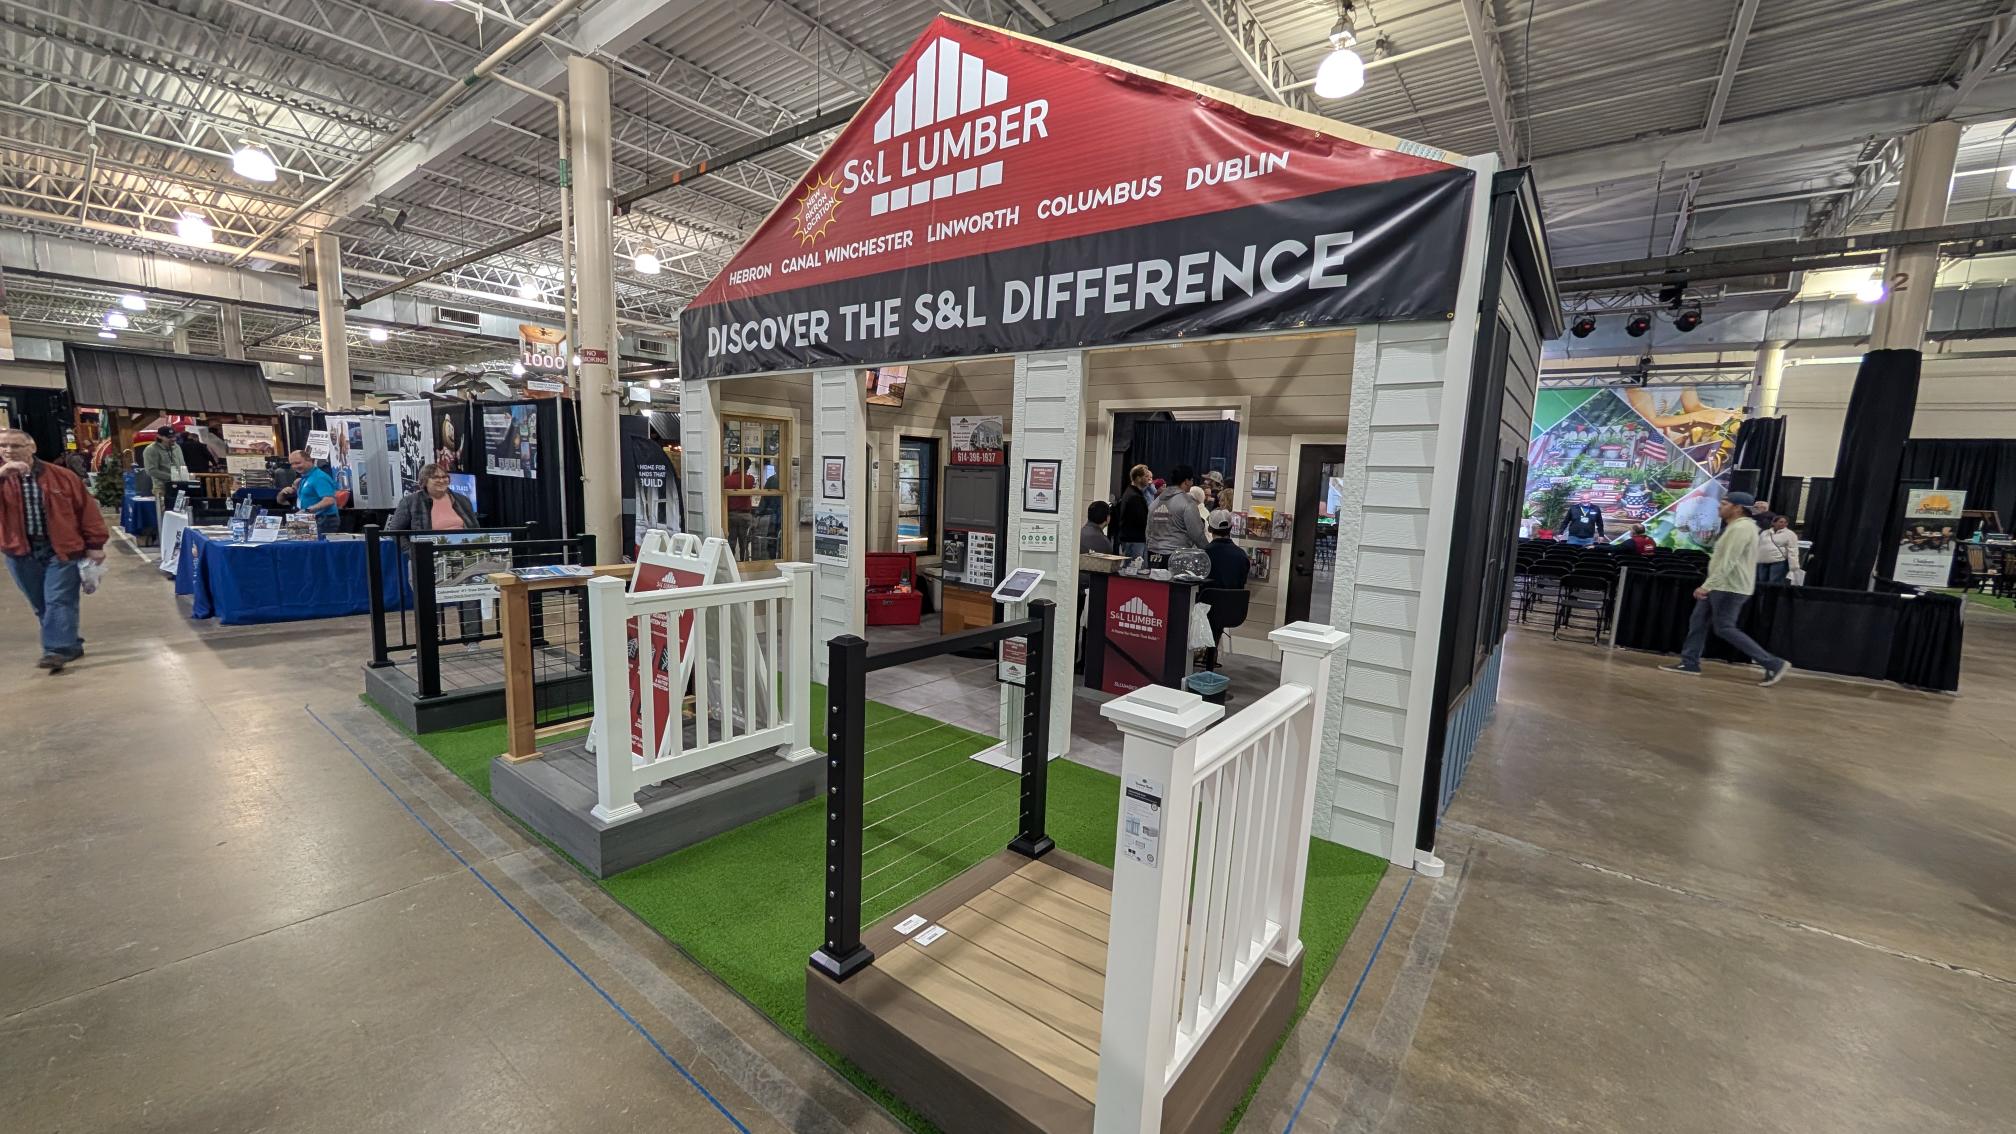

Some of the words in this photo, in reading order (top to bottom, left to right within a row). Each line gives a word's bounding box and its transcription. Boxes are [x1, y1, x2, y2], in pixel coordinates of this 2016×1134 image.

[843, 151, 892, 194] S&L
[902, 99, 1049, 177] LUMBER
[805, 193, 828, 222] AKRON
[806, 188, 821, 209] NEW
[729, 262, 772, 286] HEBRON
[781, 251, 822, 274] CANAL
[825, 230, 914, 263] WINCHESTER
[927, 206, 1020, 243] LINWORTH
[1037, 175, 1162, 220] COLUMBUS
[1185, 151, 1290, 191] DUBLIN
[803, 197, 835, 235] LOCATION
[708, 309, 830, 358] DISCOVER
[839, 298, 902, 342] THE
[912, 285, 987, 333] S&L
[1001, 231, 1354, 324] DIFFERENCE
[1890, 272, 1909, 292] 2
[523, 352, 566, 370] 1000
[957, 452, 996, 463] 614-396-1937
[1110, 610, 1125, 621] S&L
[1127, 614, 1163, 628] LUMBER
